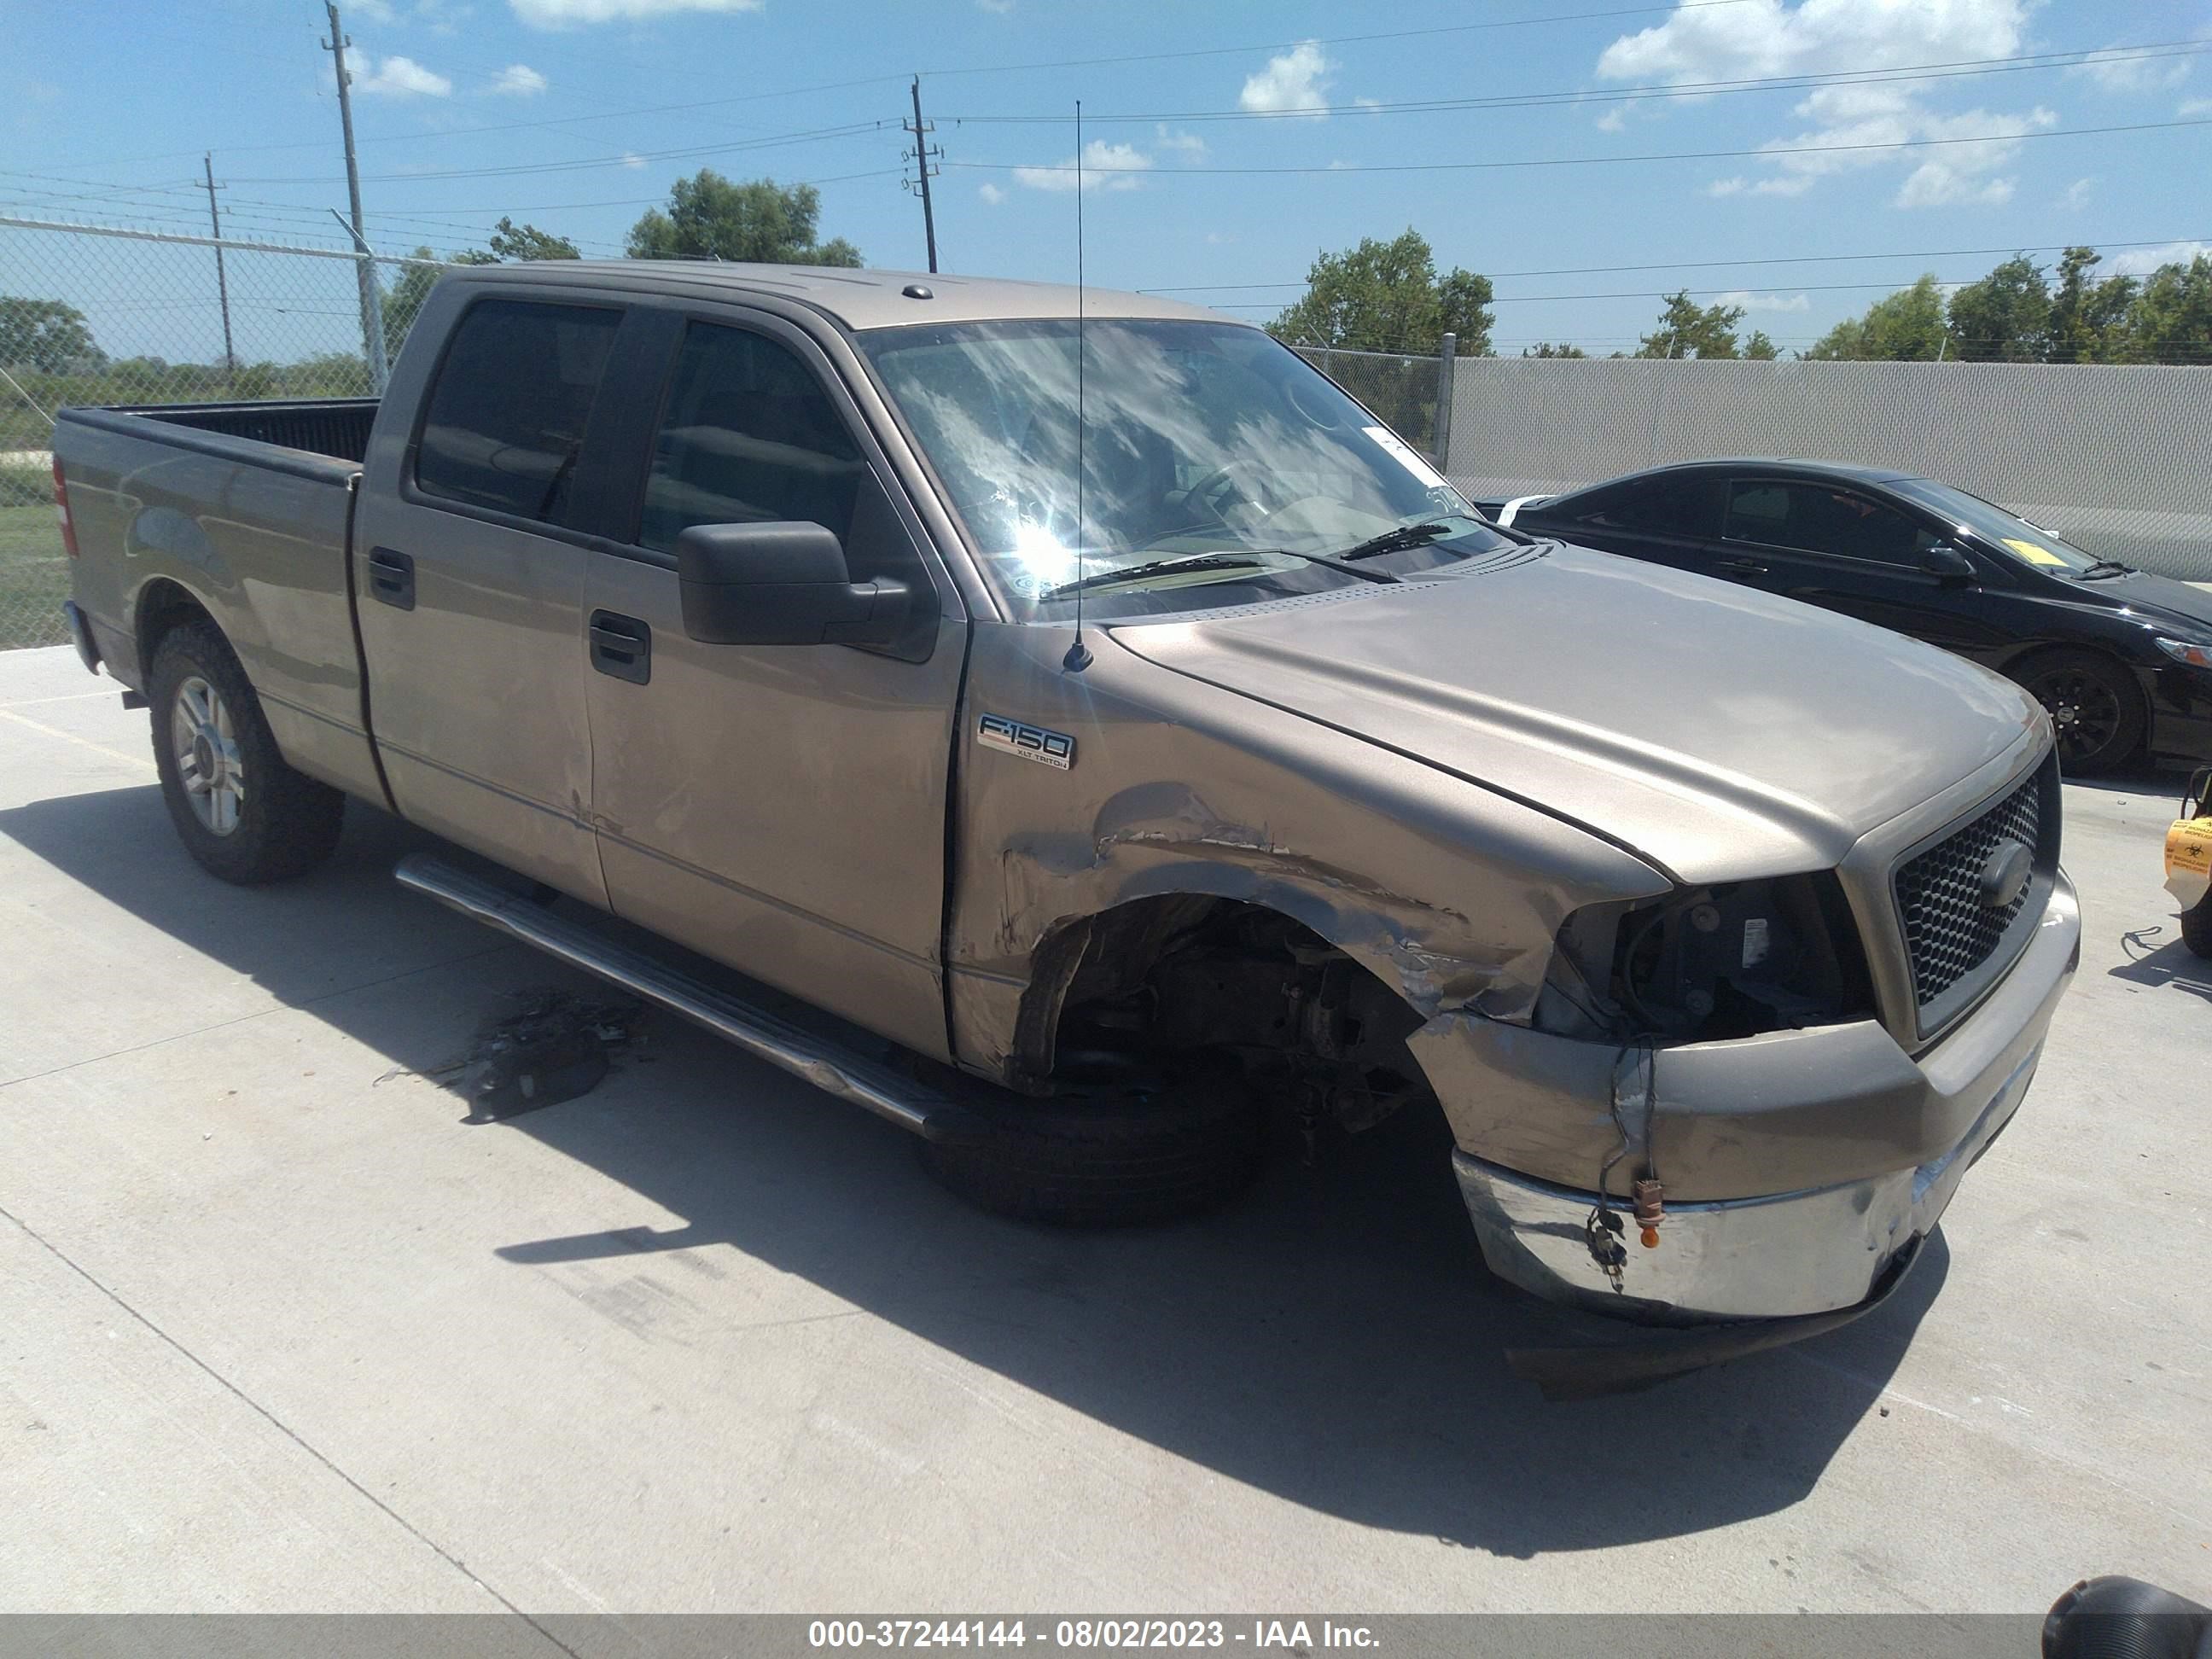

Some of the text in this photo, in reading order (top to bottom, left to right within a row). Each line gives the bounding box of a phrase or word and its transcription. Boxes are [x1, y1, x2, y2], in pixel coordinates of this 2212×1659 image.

[980, 716, 1070, 759] F-150
[1016, 748, 1068, 769] XLT TRITON
